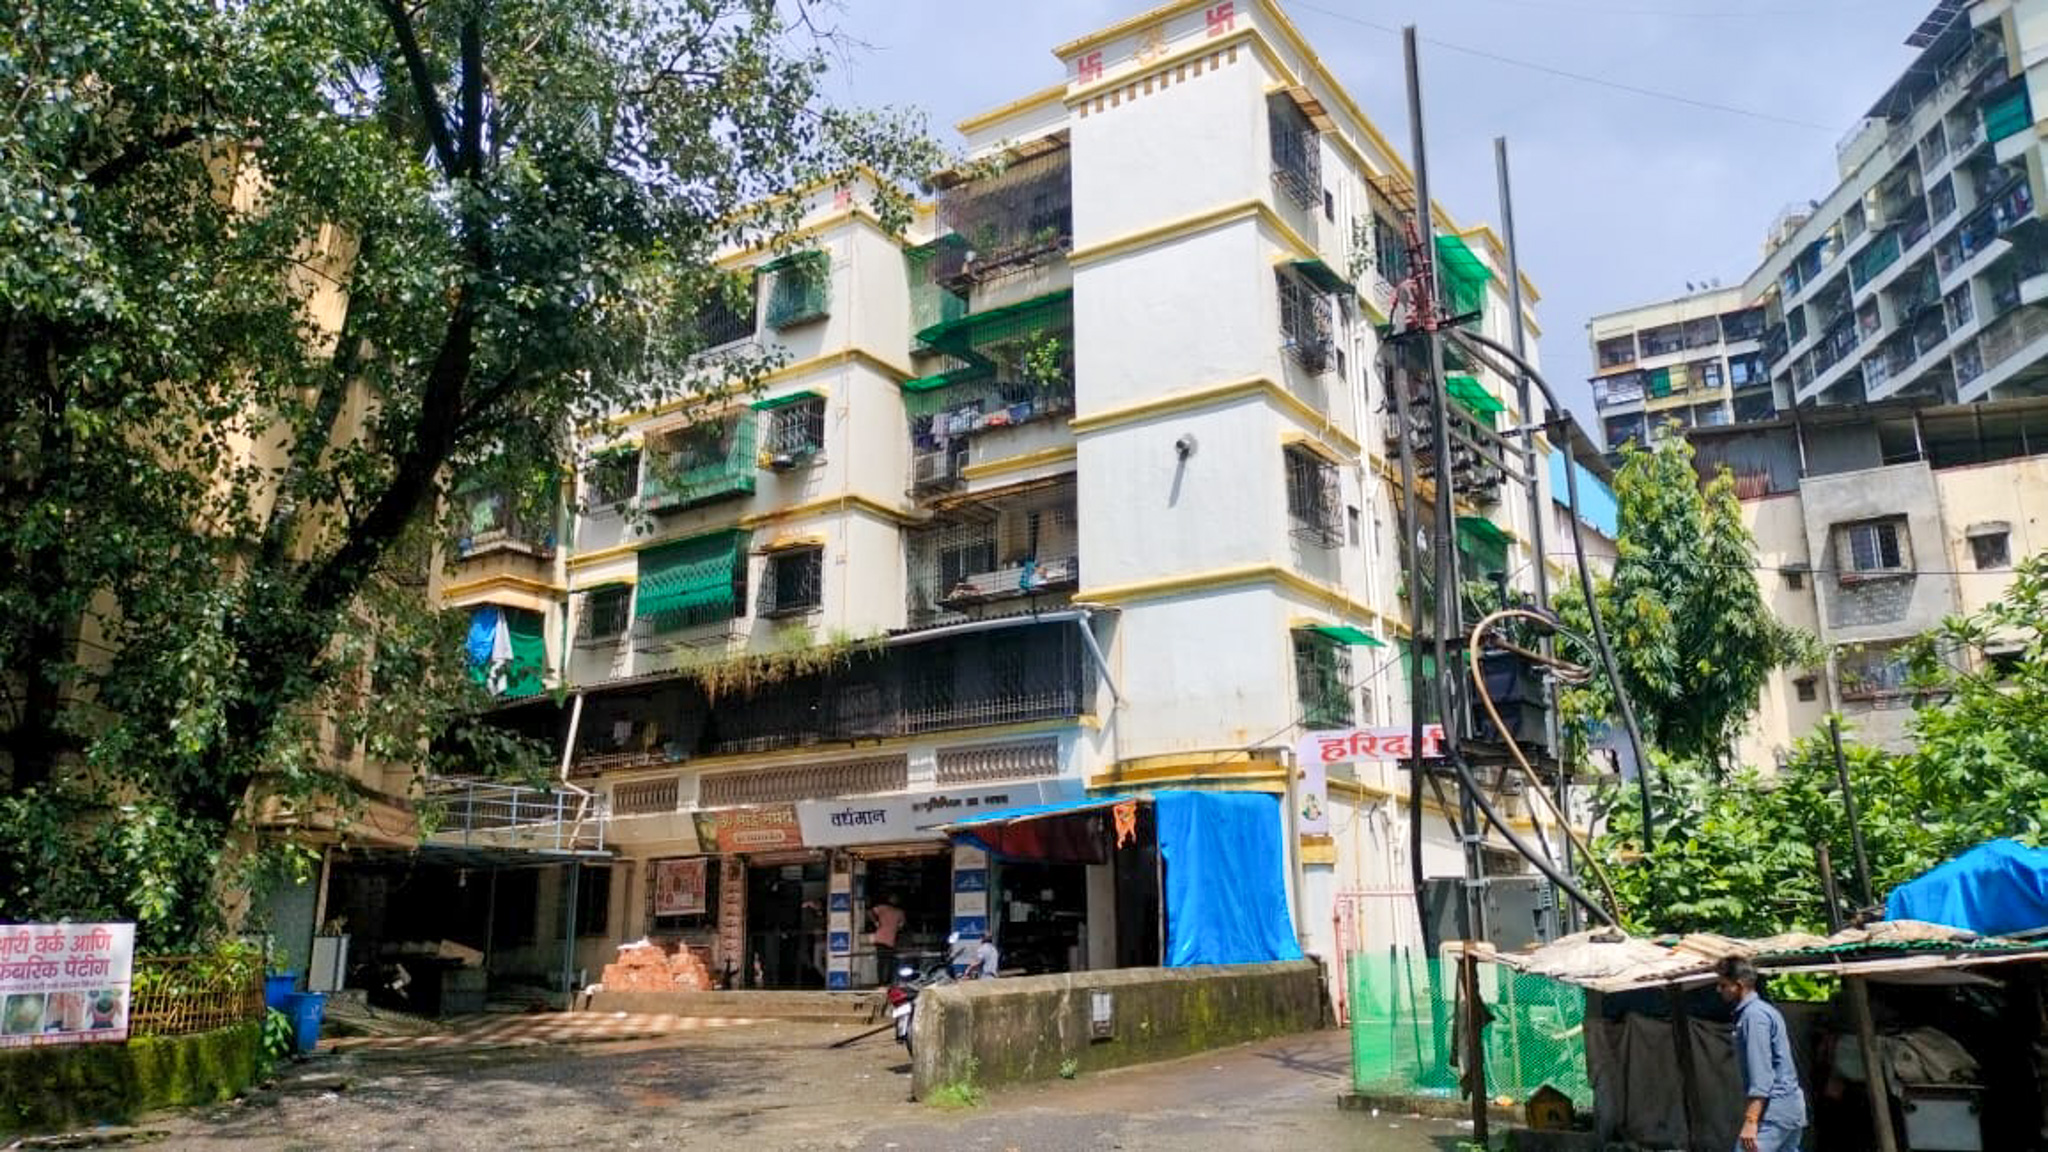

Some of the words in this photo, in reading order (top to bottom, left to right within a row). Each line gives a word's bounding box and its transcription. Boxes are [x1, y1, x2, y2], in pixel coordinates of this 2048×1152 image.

[829, 807, 888, 827] वर्धमान
[35, 928, 65, 954] वर्क
[70, 928, 112, 952] आणि
